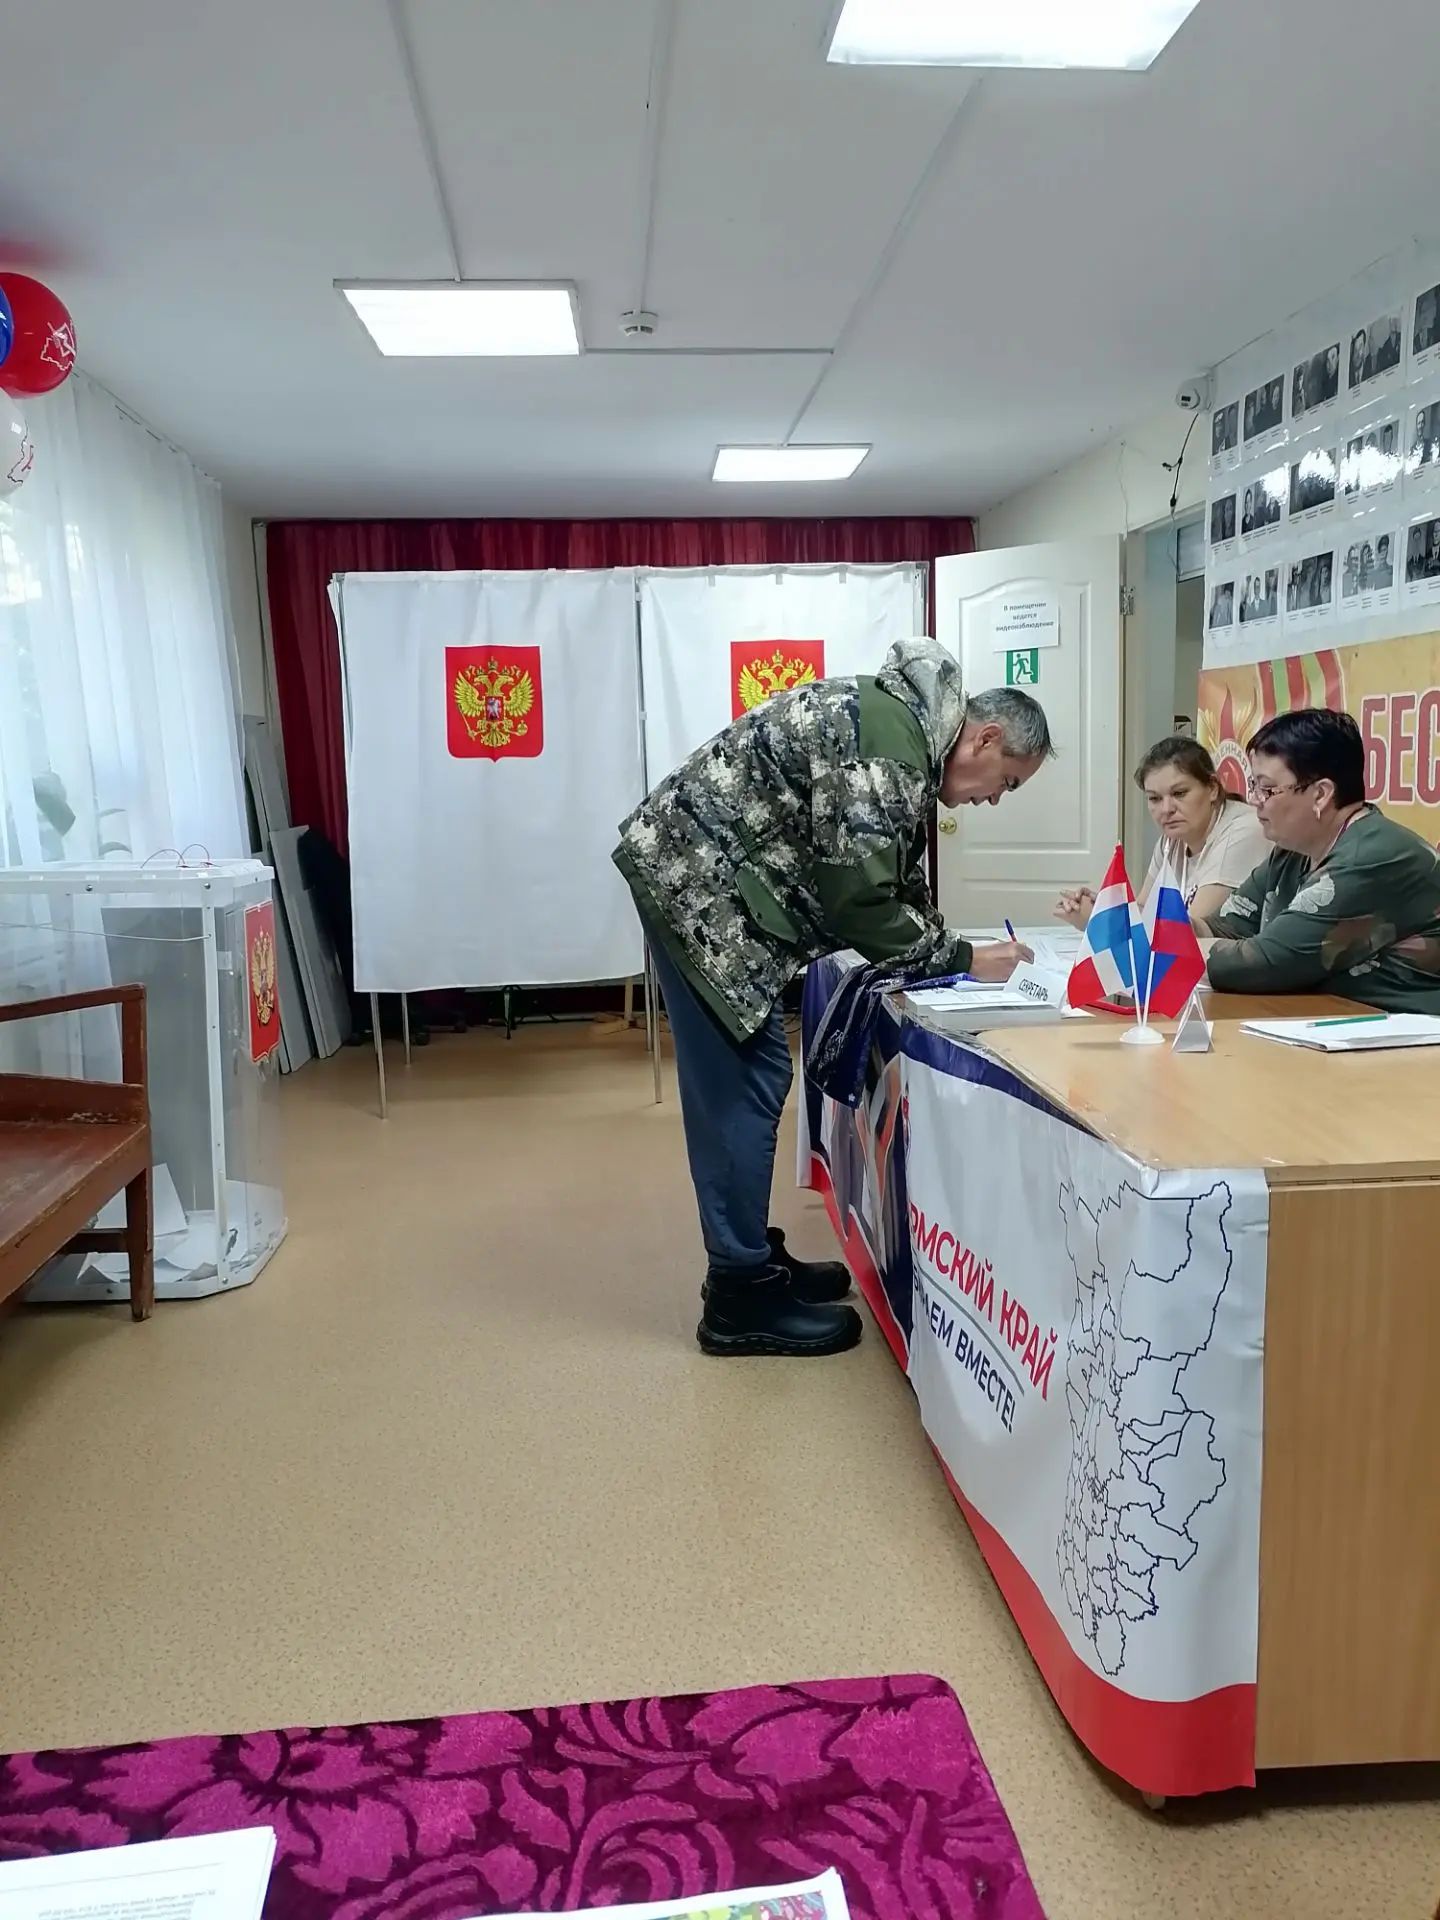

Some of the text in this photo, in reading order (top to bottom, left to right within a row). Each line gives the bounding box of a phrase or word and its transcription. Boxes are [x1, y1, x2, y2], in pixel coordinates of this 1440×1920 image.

[1018, 978, 1049, 1001] СЕКРЕТАРЬ
[955, 1327, 1016, 1433] ВМЕСТЕ!
[999, 1288, 1058, 1401] КРАЙ
